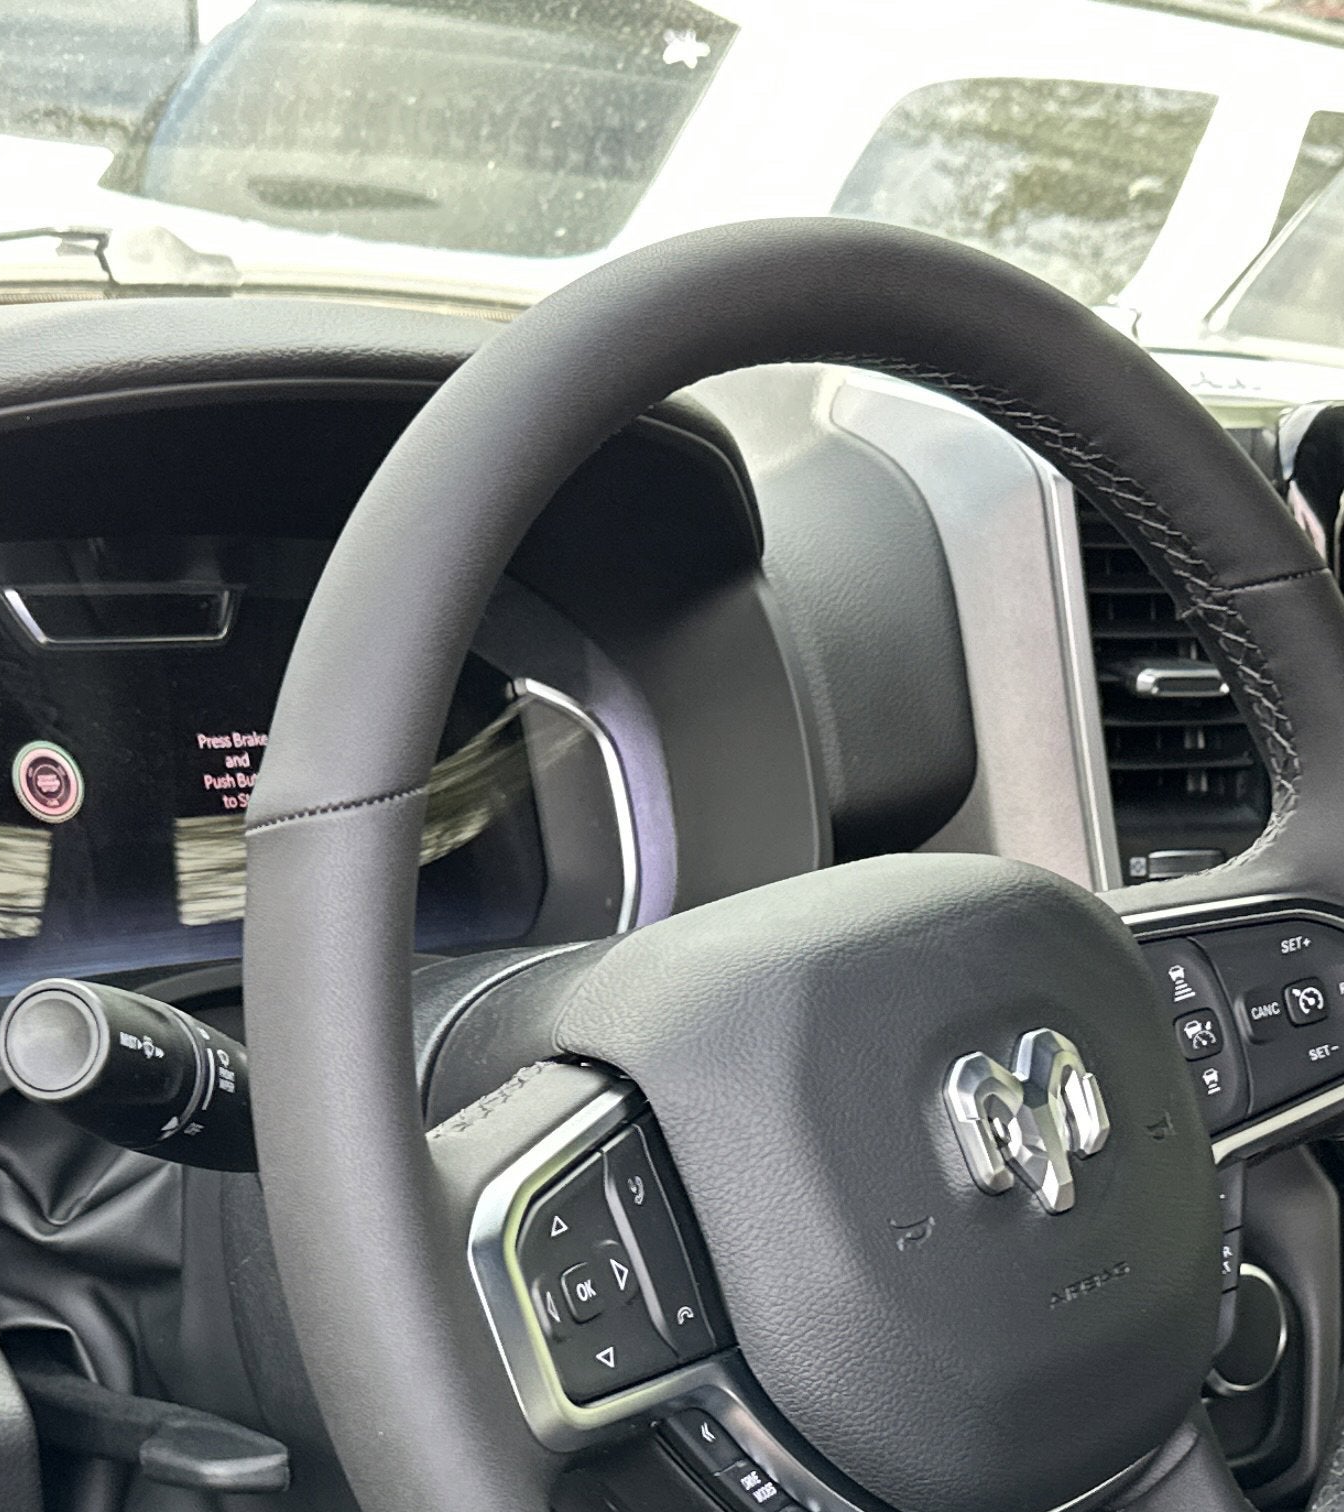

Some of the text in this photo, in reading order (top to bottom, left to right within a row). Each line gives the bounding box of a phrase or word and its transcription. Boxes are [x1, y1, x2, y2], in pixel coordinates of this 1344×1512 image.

[197, 731, 267, 749] Press Brake
[225, 751, 250, 768] and
[203, 773, 236, 790] Push
[222, 794, 238, 809] to
[1281, 936, 1311, 954] SET+
[1251, 1002, 1280, 1020] CANC
[1309, 1044, 1339, 1061] SET-
[576, 1279, 596, 1301] OK
